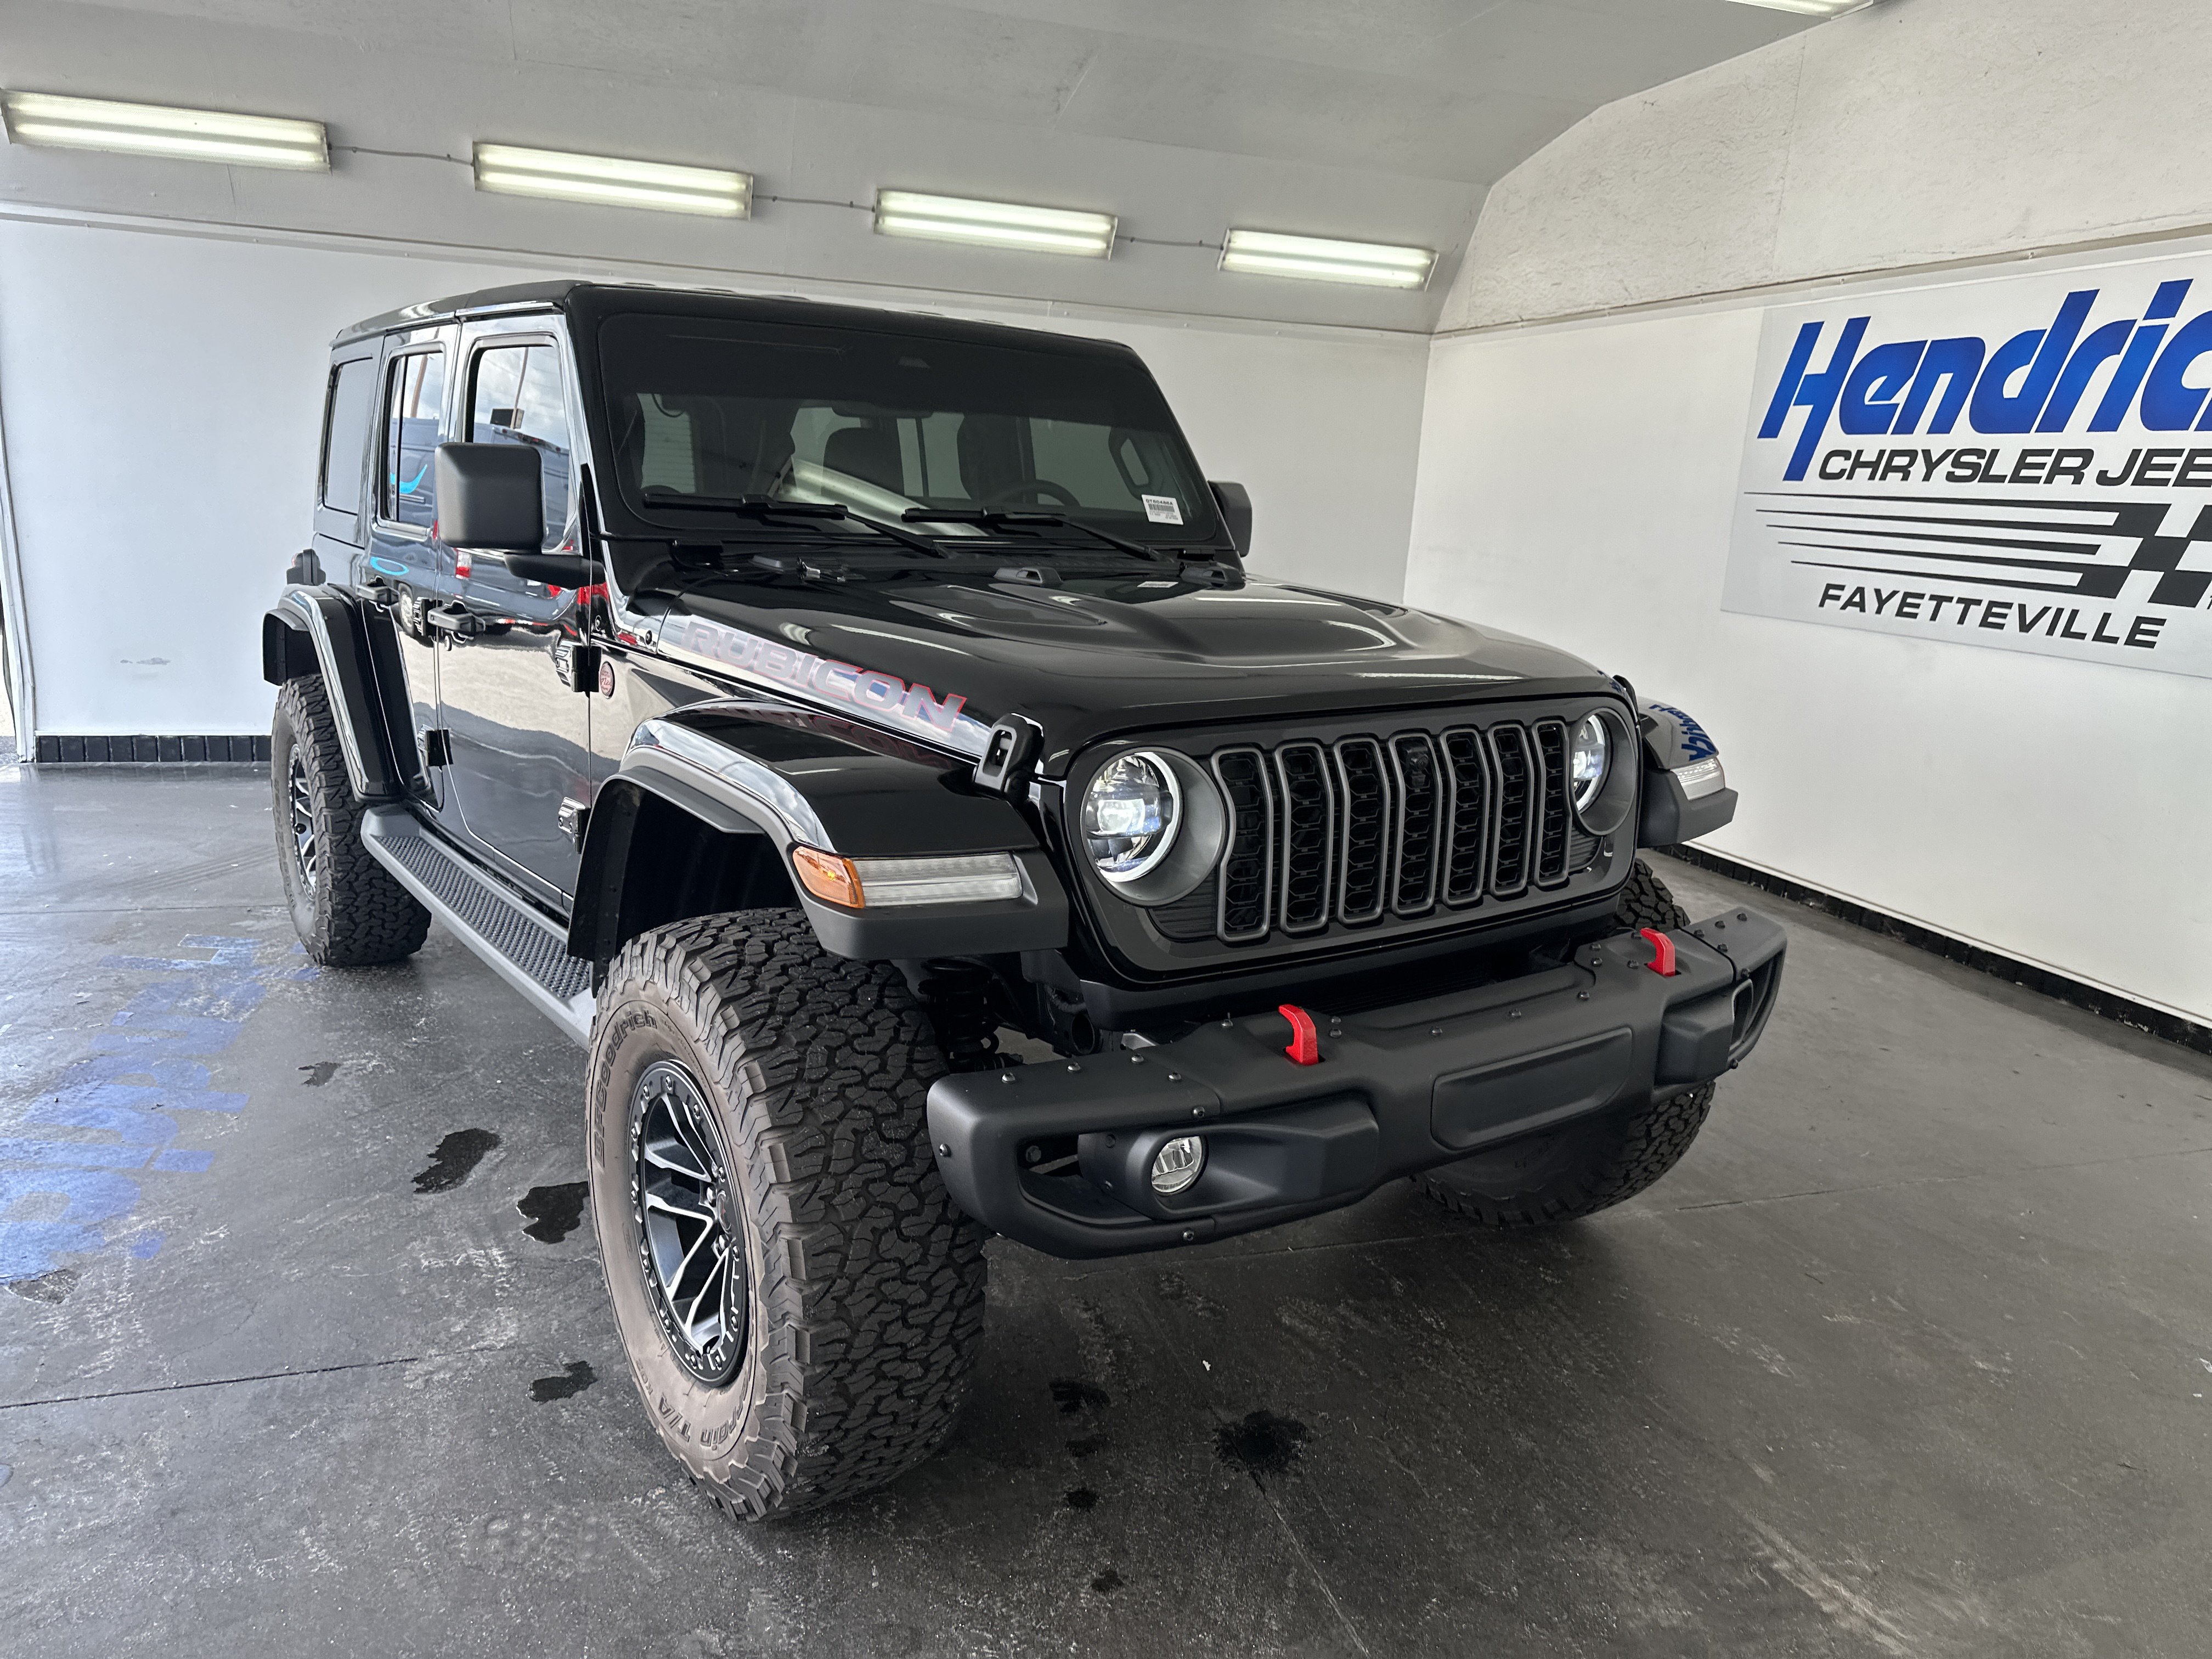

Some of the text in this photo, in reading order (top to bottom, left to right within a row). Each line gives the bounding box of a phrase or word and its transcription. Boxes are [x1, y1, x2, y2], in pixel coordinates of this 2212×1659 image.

[1757, 279, 2212, 481] Hendric
[1819, 448, 2095, 485] CHRYSLER
[1818, 583, 2168, 649] FAYETTEVILLE
[681, 621, 967, 732] RUBICON
[594, 1009, 658, 1167] BFGoodrich
